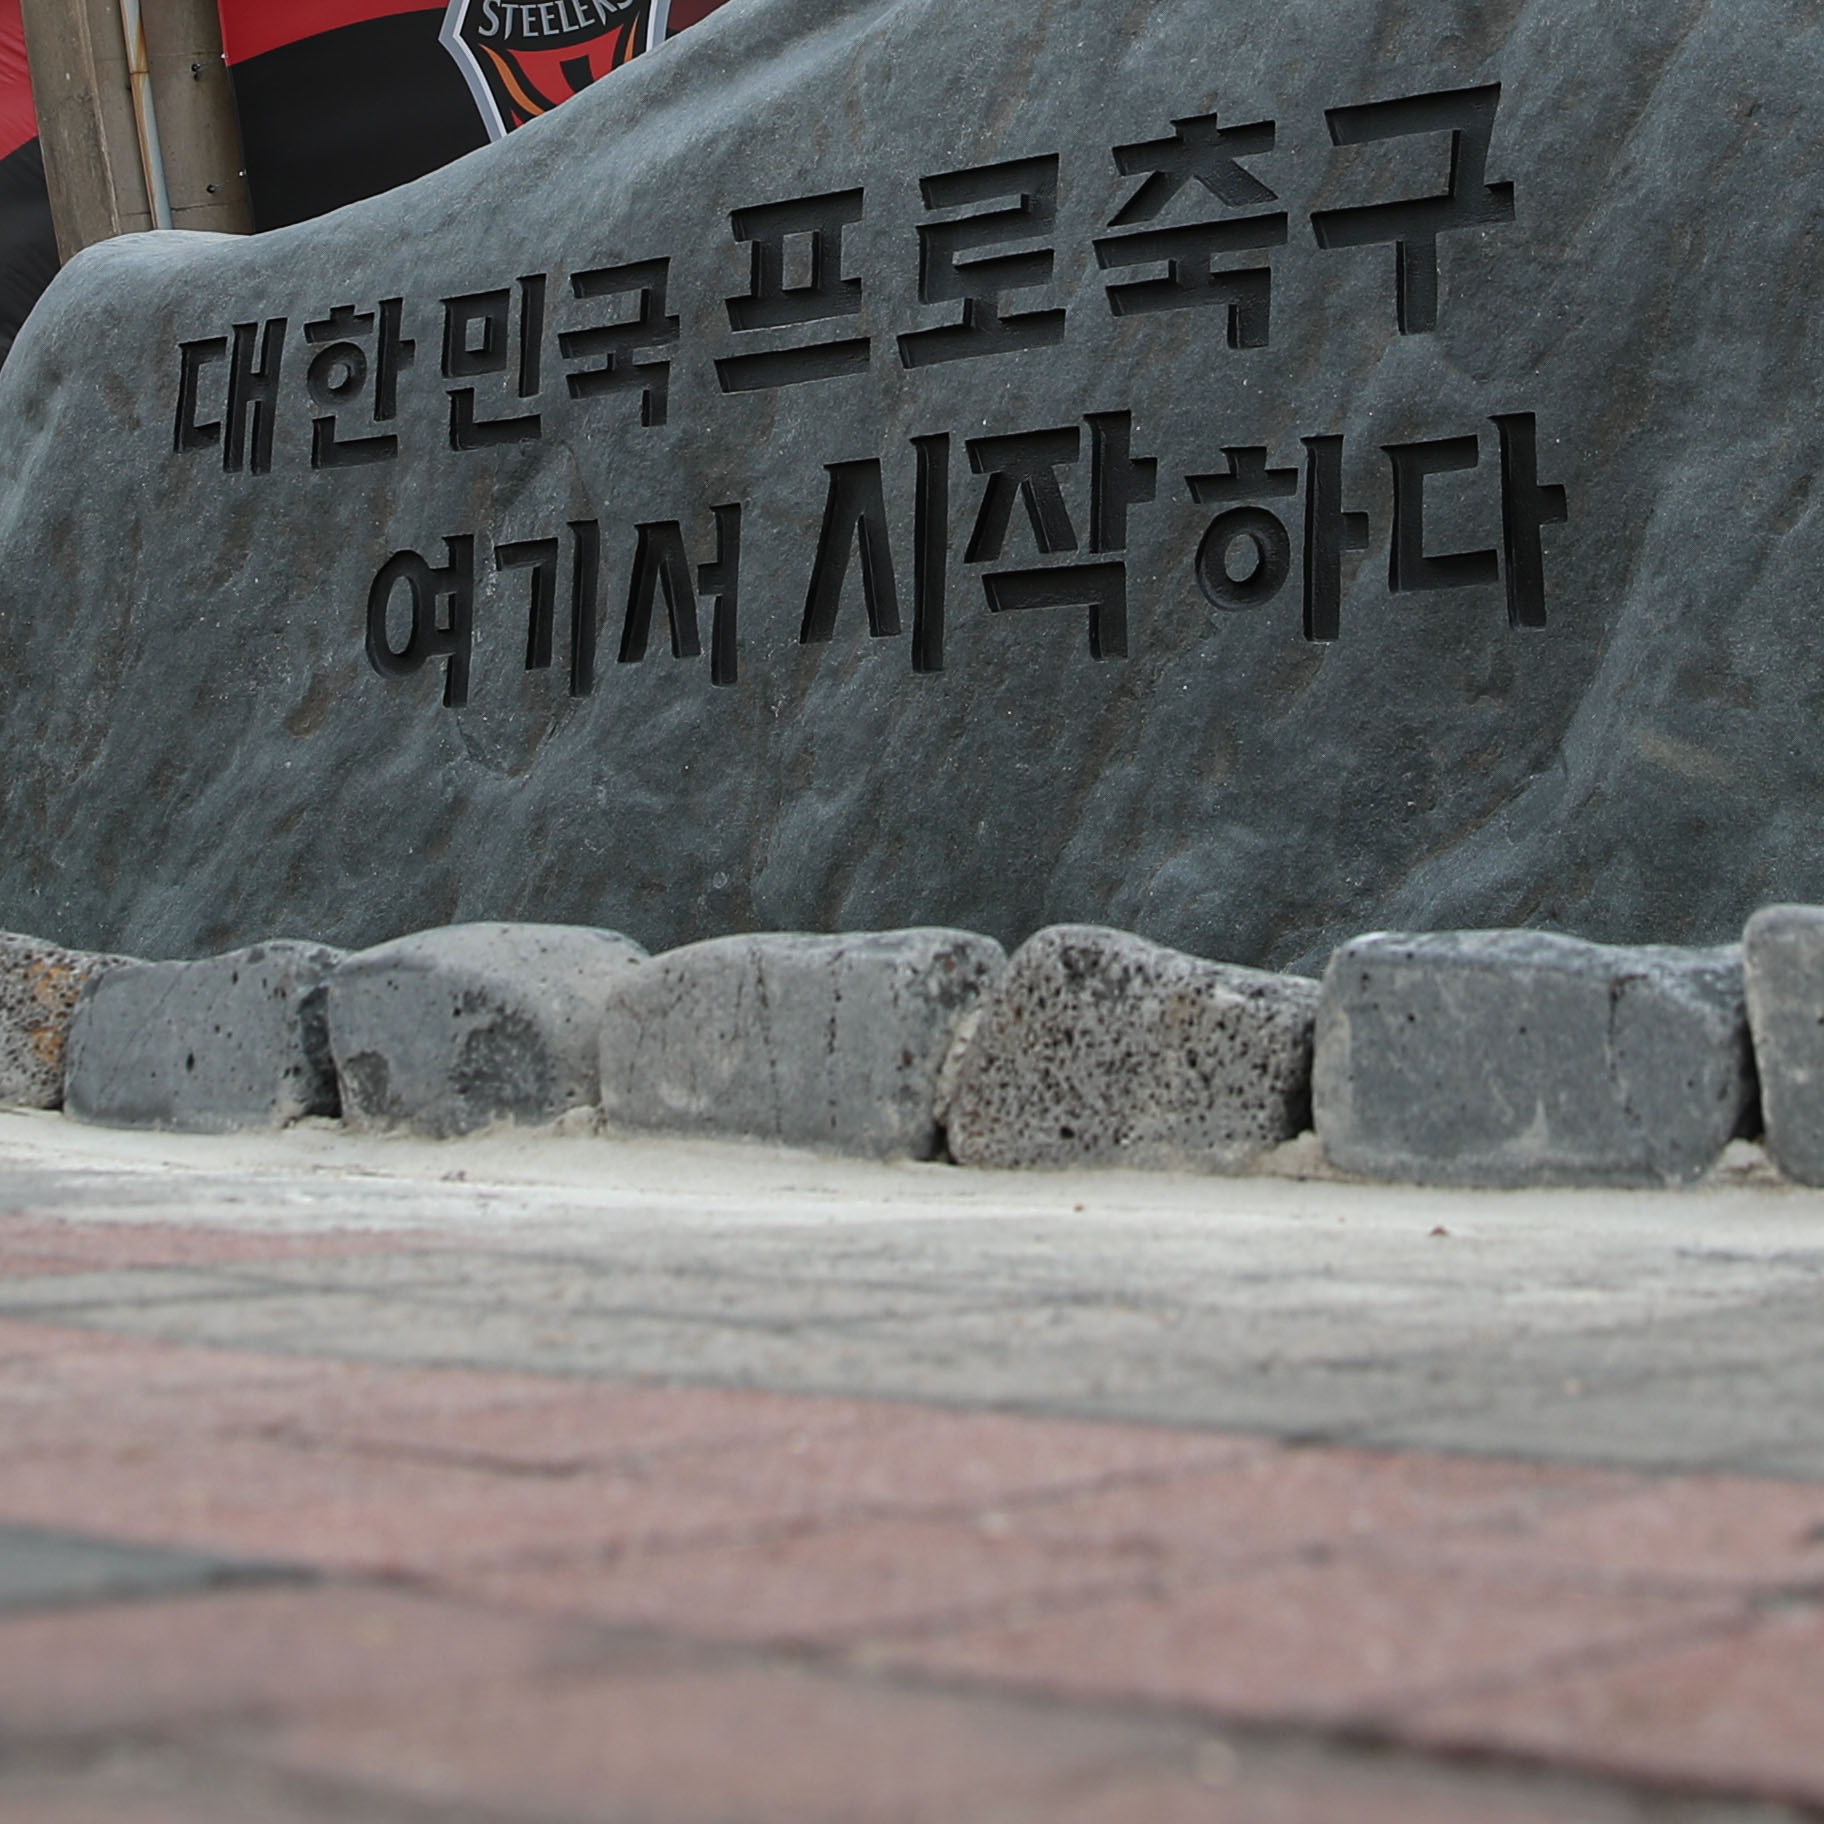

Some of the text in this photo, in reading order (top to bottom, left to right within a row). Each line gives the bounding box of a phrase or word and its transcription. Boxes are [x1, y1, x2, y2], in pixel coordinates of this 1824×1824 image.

[174, 81, 1516, 474] 대한민국 프로축구
[364, 409, 1567, 710] 여기서 시작하다
